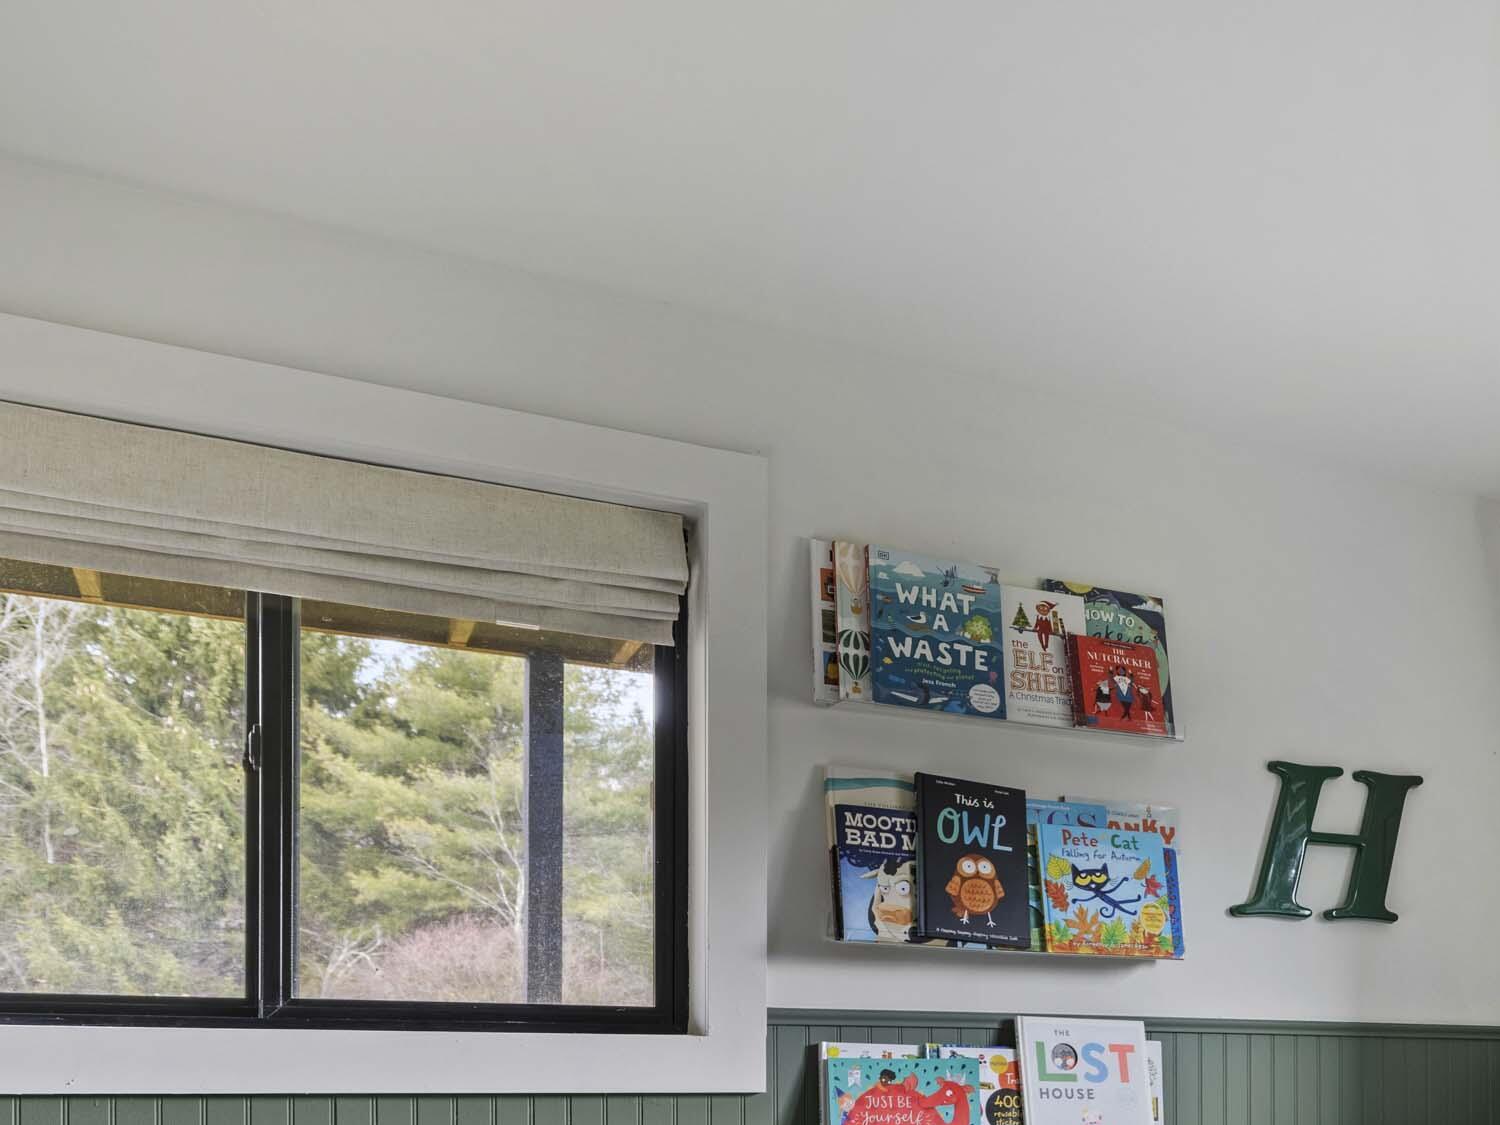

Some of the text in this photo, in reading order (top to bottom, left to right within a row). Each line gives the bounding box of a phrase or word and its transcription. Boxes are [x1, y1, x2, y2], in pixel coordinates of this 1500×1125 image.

[895, 582, 976, 616] WHAT
[932, 613, 949, 632] A
[1118, 614, 1135, 627] TO
[887, 636, 989, 672] WASTE
[1011, 640, 1029, 649] the
[1112, 648, 1125, 656] THE
[1012, 648, 1064, 674] ELF on
[1087, 650, 1152, 669] NUTCRACKER
[1015, 691, 1054, 704] Christmas
[954, 793, 995, 809] This is
[844, 828, 897, 849] BAD
[937, 807, 1013, 852] OWL
[1061, 828, 1141, 851] Pete Cat
[1229, 760, 1424, 924] H
[1061, 847, 1090, 862] Falling
[1053, 1029, 1071, 1037] THE
[1034, 1040, 1136, 1084] LOST
[865, 1095, 913, 1109] JUST BE
[1039, 1087, 1097, 1101] HOUSE
